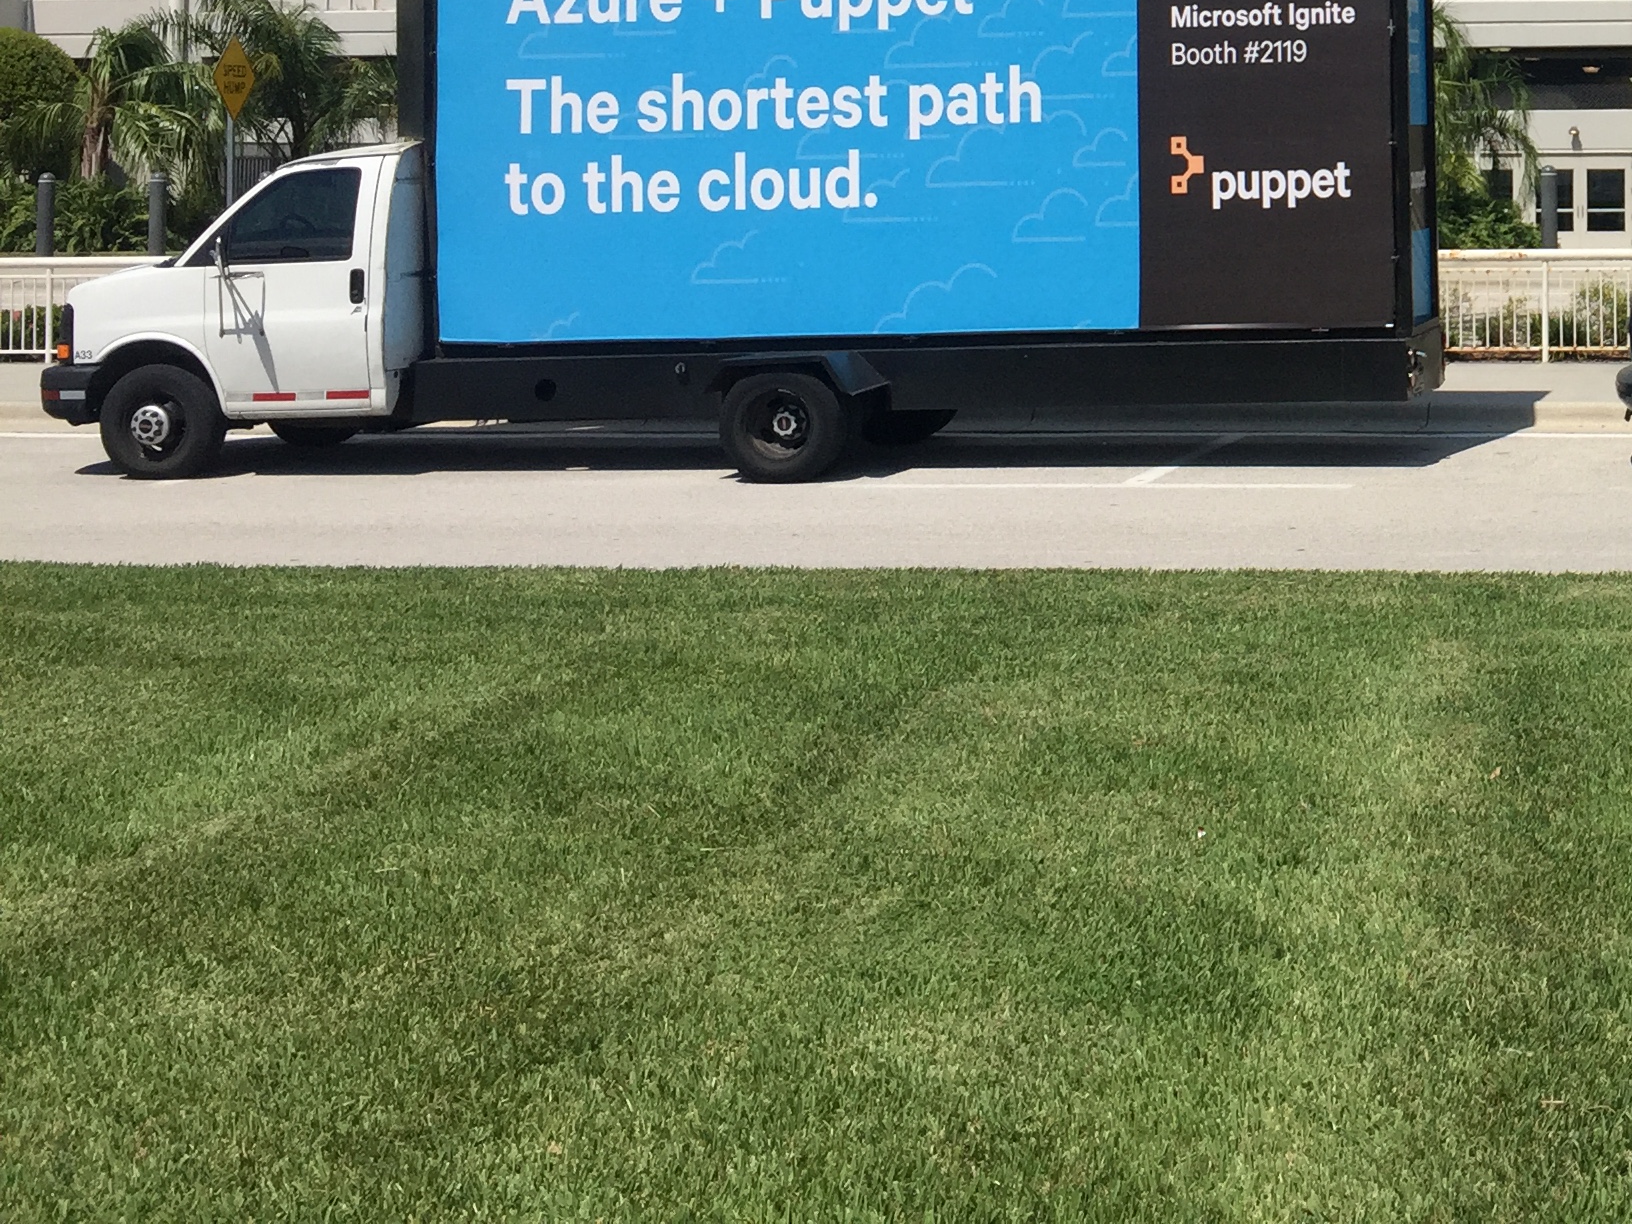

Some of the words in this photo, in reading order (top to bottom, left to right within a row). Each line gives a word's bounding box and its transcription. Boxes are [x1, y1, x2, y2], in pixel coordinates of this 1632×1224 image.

[1171, 1, 1283, 29] Microsoft
[1288, 0, 1356, 31] Ignite
[1171, 40, 1237, 66] Booth
[1243, 39, 1308, 64] #2119
[223, 64, 247, 78] SPEED
[223, 80, 246, 94] HUMP
[506, 75, 619, 135] The
[637, 73, 888, 133] shortest
[908, 64, 1042, 140] path
[504, 163, 566, 215] to
[582, 154, 680, 214] the
[698, 148, 878, 212] cloud.
[1211, 161, 1352, 210] puppet
[75, 350, 93, 360] A33
